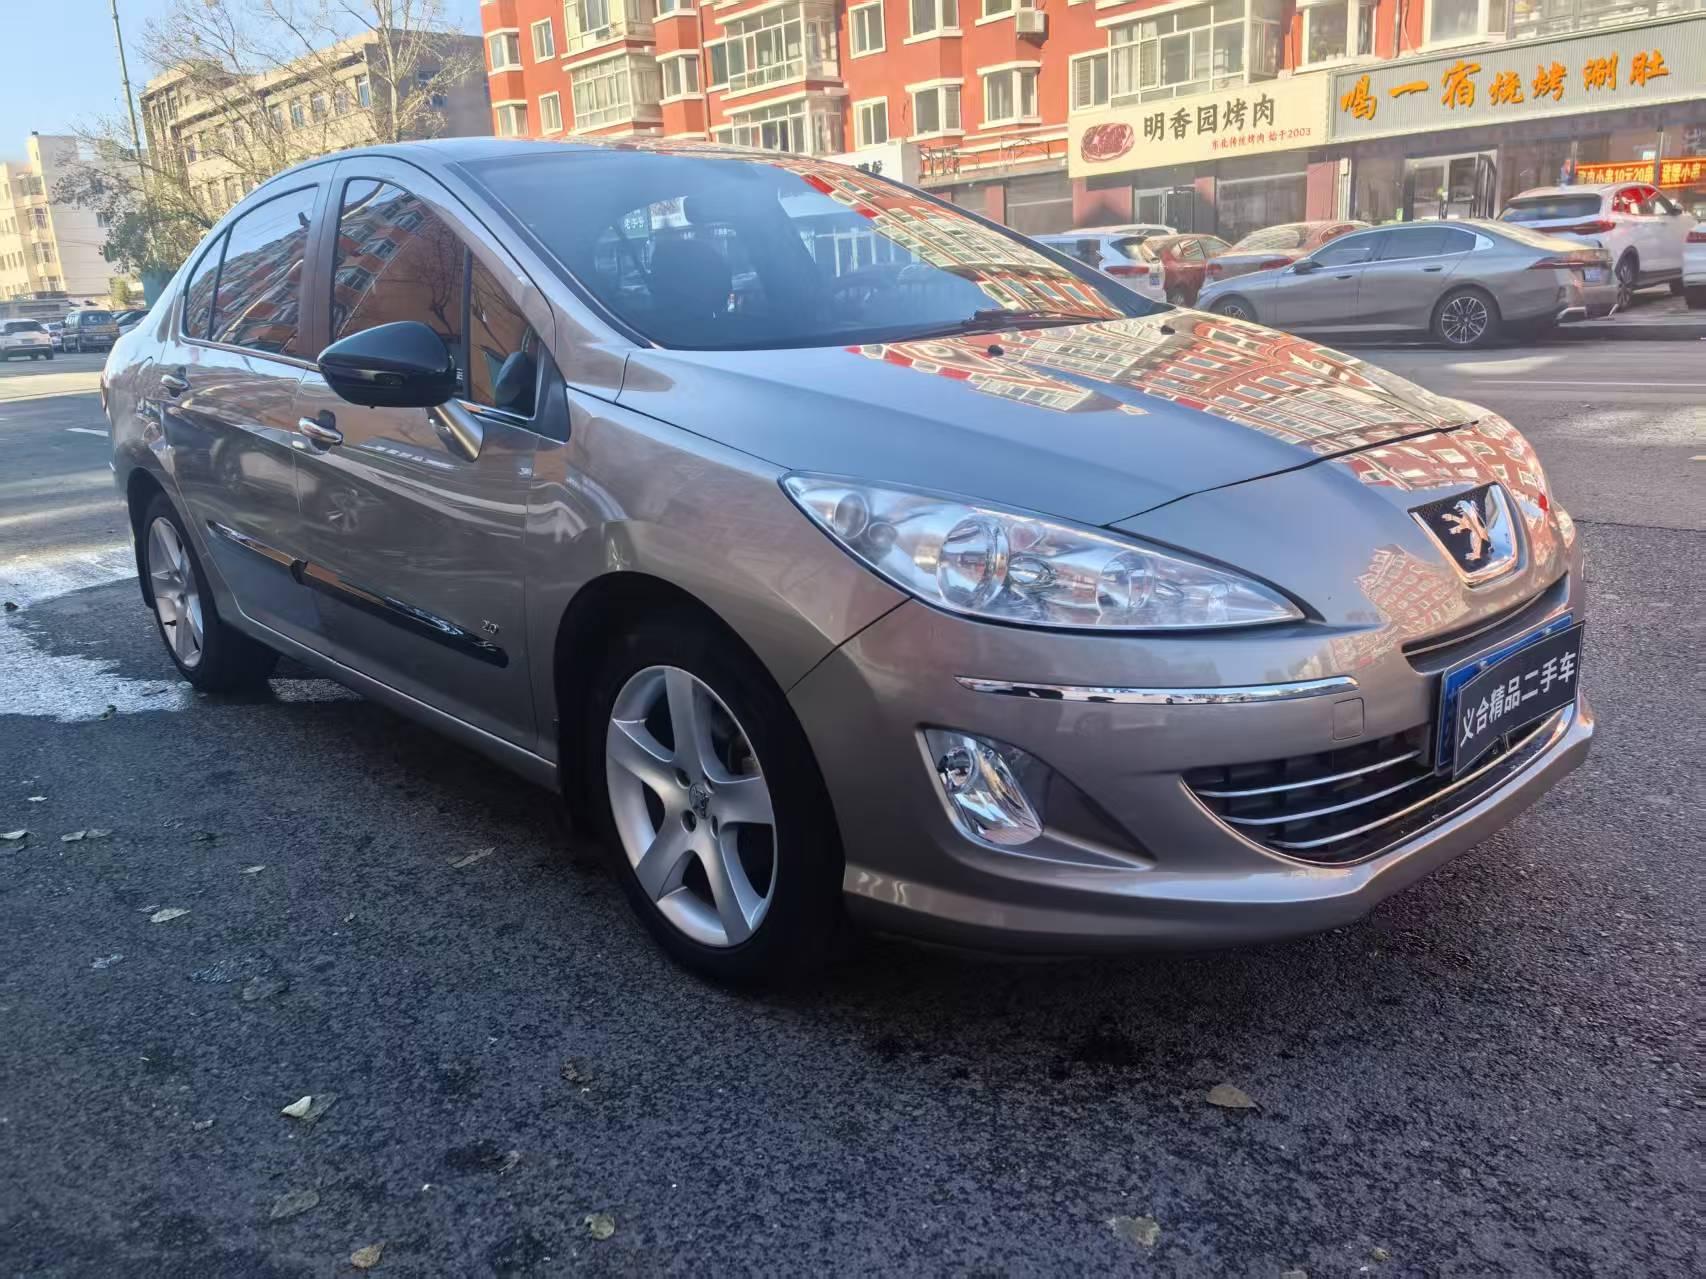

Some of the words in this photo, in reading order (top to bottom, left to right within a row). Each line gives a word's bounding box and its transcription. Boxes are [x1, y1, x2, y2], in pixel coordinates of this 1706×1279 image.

[1340, 49, 1670, 120] 喝一宿烧烤涮肚
[1144, 94, 1275, 142] 明香园烤肉
[1211, 132, 1265, 150] 东北传统烤肉
[1268, 127, 1312, 141] 始于2003
[1460, 651, 1576, 748] 义合精品二手车
